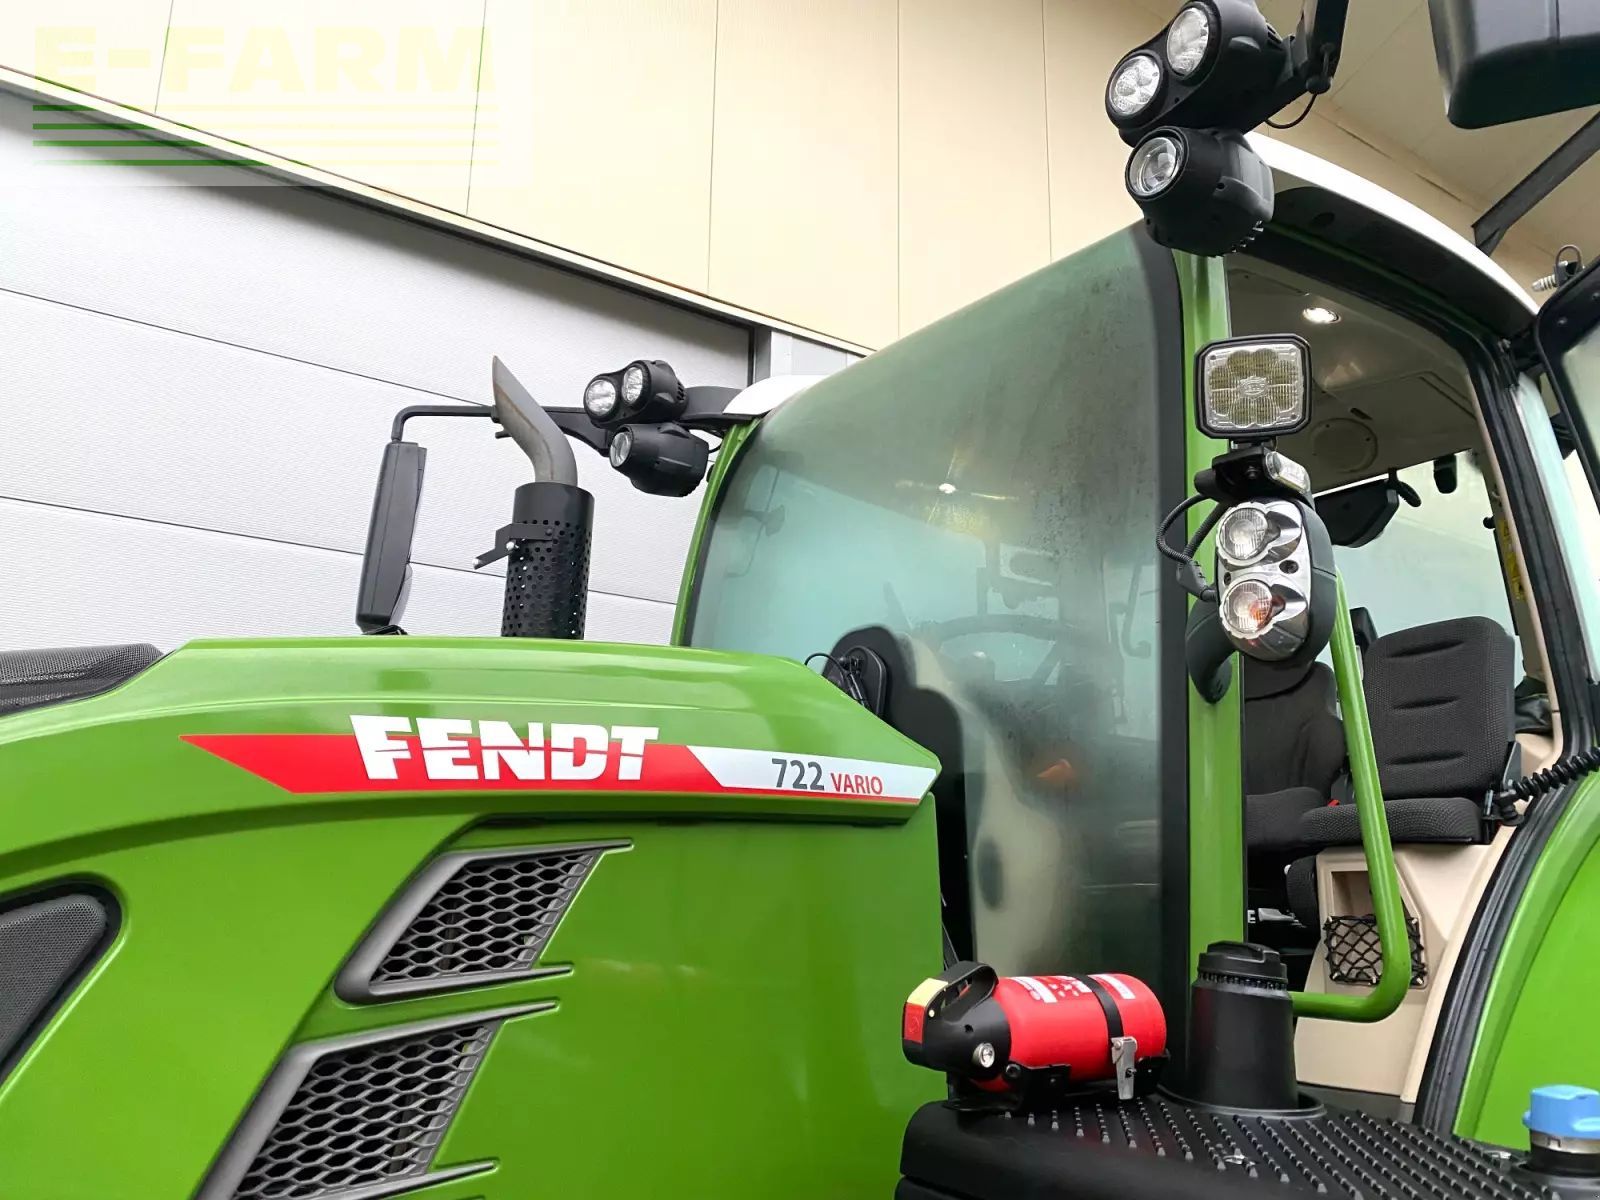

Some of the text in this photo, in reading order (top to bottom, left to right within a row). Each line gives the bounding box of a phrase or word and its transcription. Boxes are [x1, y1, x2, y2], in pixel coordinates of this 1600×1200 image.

[349, 714, 884, 796] FENDT 722 VARIO
